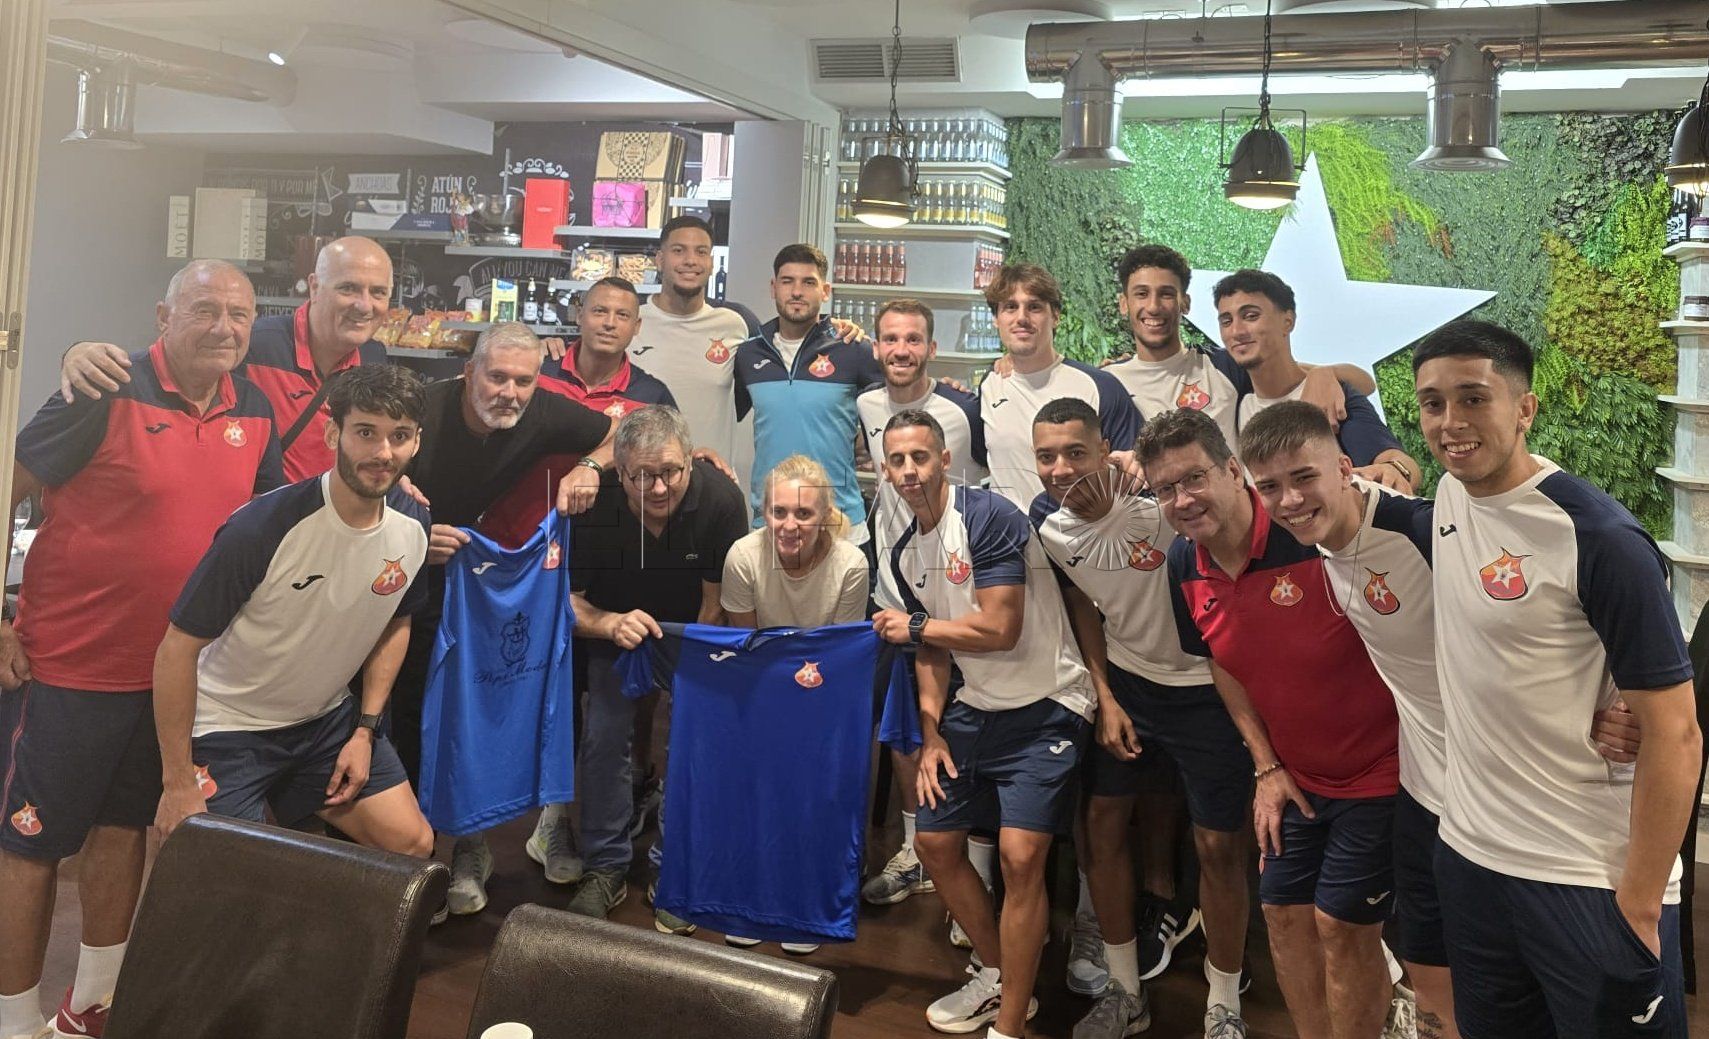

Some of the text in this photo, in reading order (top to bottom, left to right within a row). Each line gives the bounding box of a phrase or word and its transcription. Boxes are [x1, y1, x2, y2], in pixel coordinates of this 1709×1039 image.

[431, 174, 463, 194] ATÚN
[431, 196, 453, 214] ROJ
[503, 260, 523, 278] YOU
[525, 260, 548, 277] CAN
